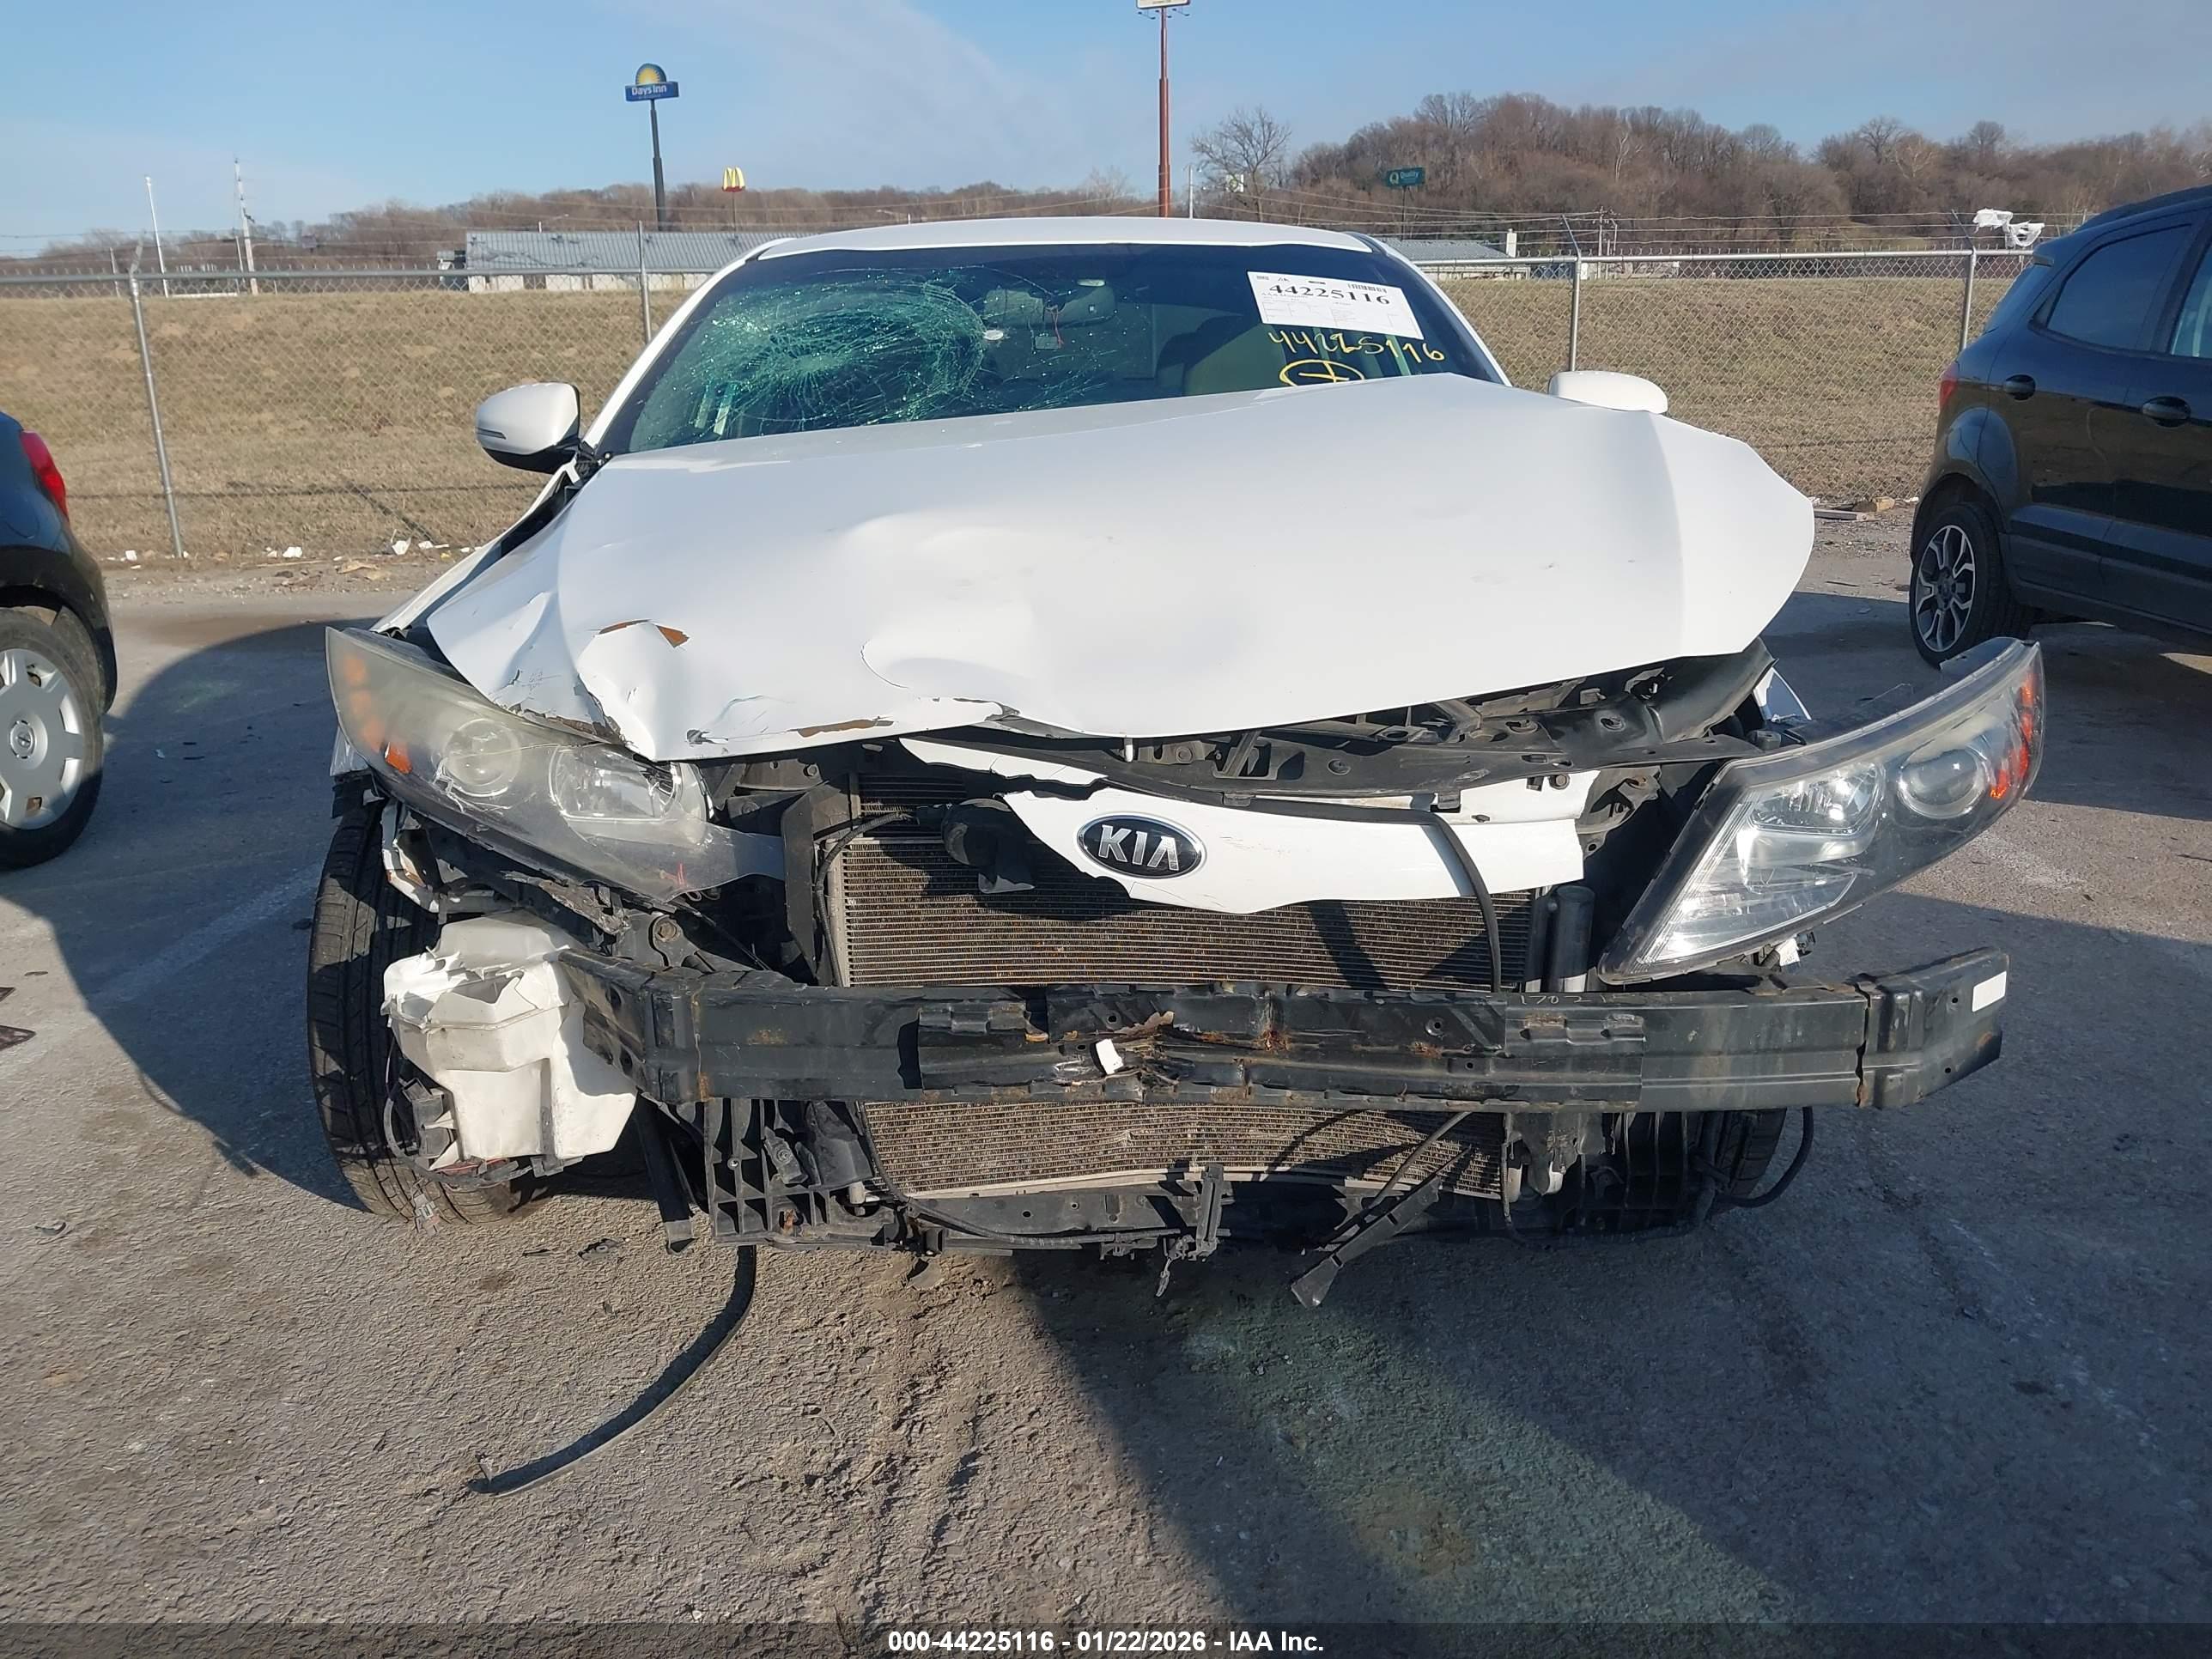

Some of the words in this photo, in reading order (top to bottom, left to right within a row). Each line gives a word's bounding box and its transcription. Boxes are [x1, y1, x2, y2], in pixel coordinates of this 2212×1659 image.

[631, 87, 652, 96] Days
[653, 85, 667, 94] Inn
[1269, 284, 1390, 305] 44225116
[1098, 824, 1179, 872] KIA
